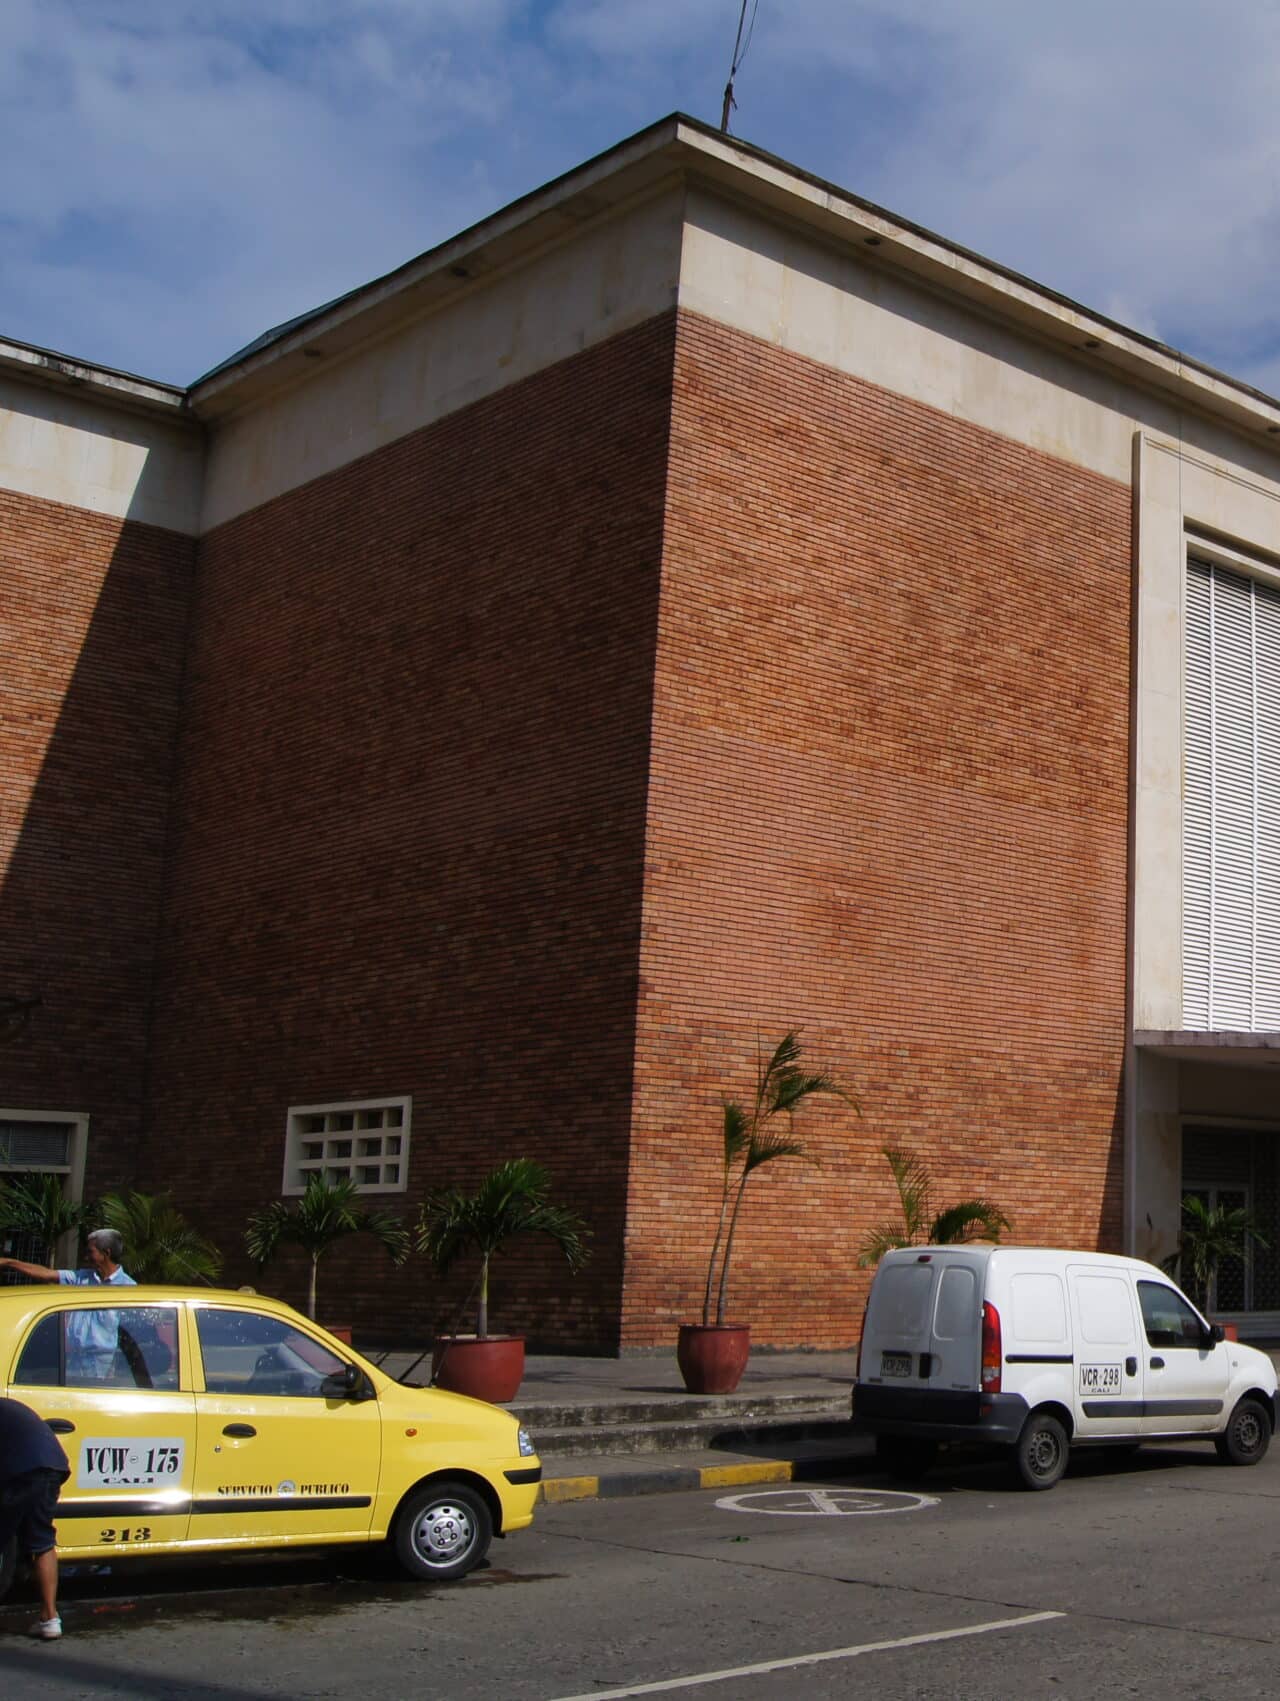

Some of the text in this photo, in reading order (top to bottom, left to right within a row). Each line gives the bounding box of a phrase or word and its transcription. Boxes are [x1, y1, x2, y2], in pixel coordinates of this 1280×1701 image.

[217, 1483, 349, 1496] SERVICIO PUBLICO
[100, 1527, 151, 1542] 213
